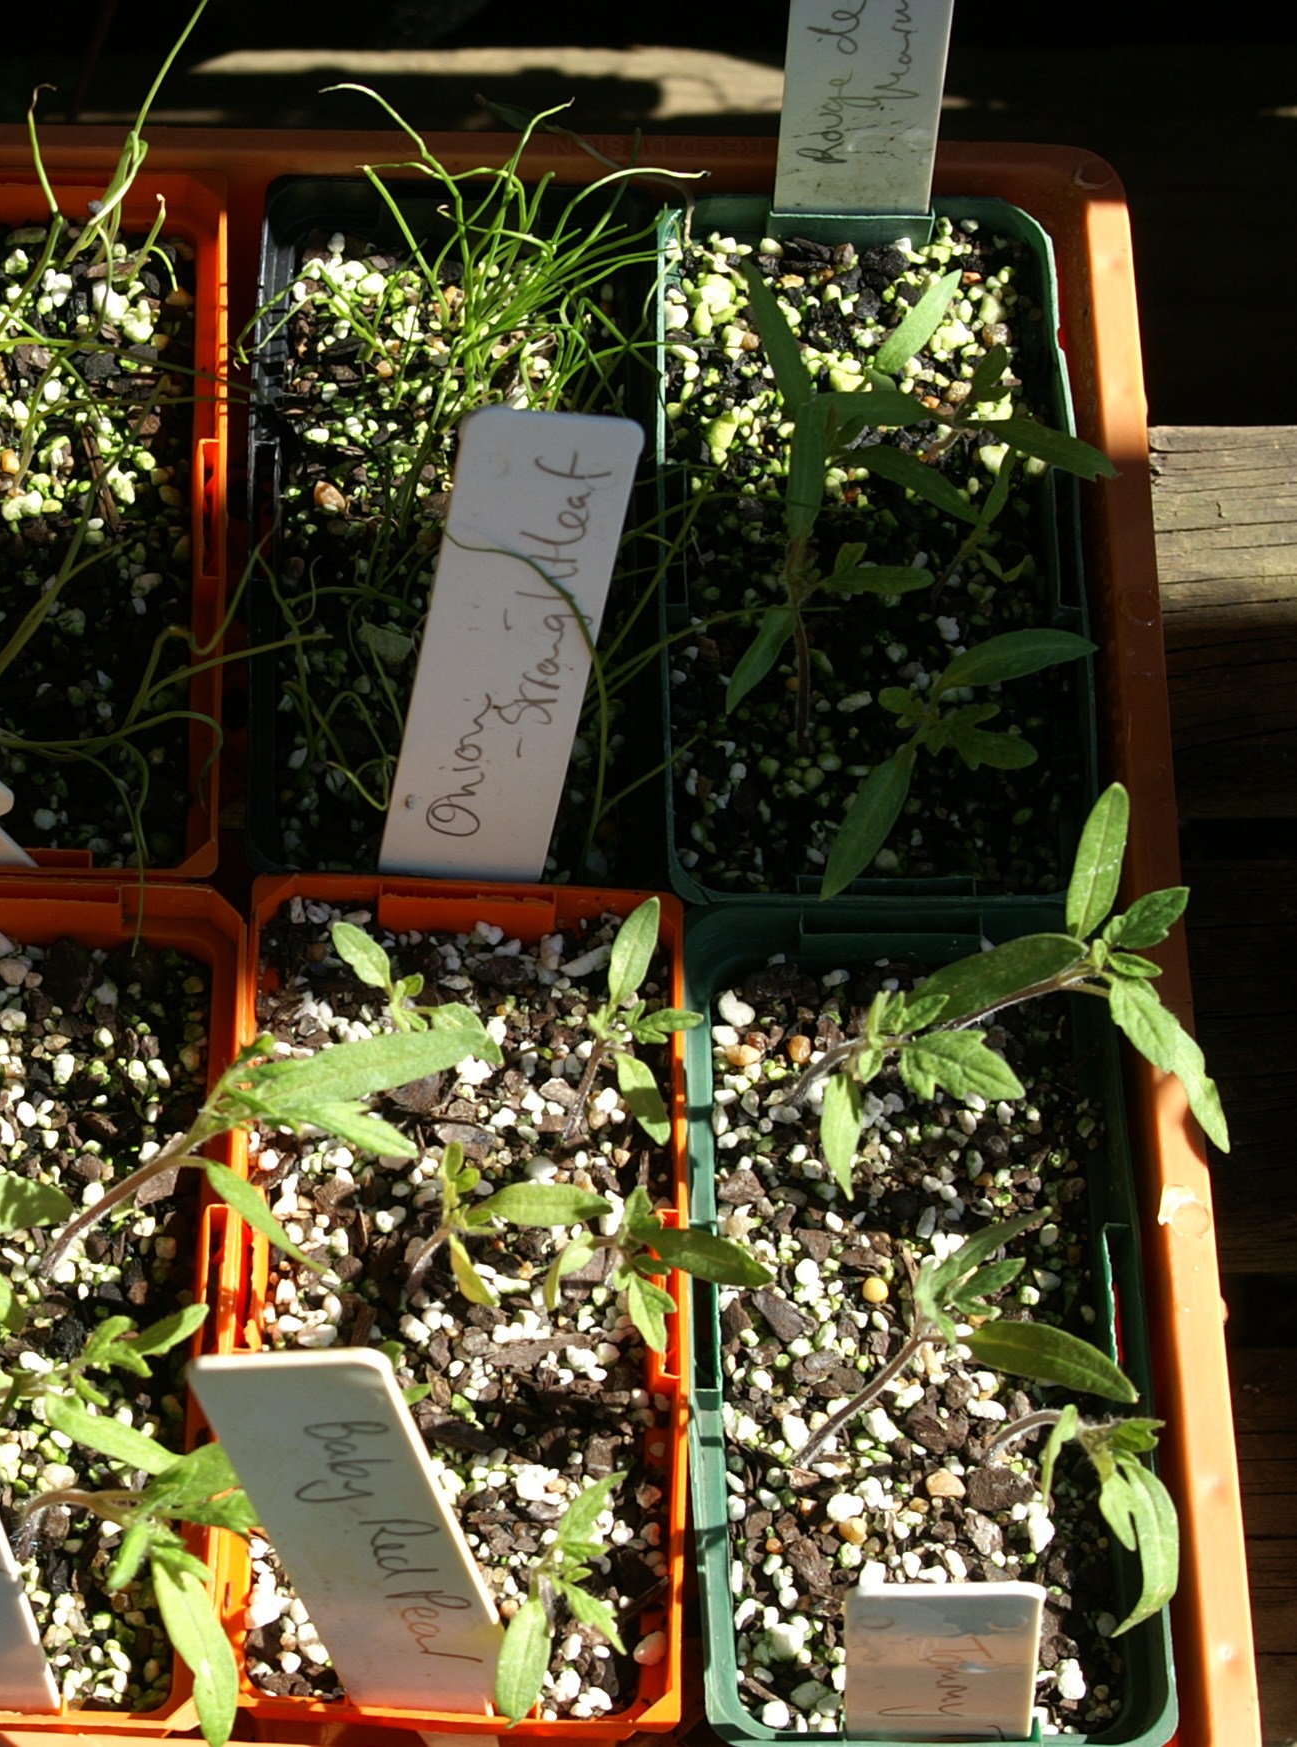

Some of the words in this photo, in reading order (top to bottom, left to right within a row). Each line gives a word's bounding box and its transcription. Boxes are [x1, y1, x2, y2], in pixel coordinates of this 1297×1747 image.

[806, 0, 867, 55] de
[796, 70, 882, 165] Rouge
[425, 693, 493, 837] Onion
[294, 1420, 390, 1503] Baby
[359, 1518, 441, 1580] Red
[384, 1589, 485, 1664] Pear
[877, 1635, 994, 1718] Tommy
